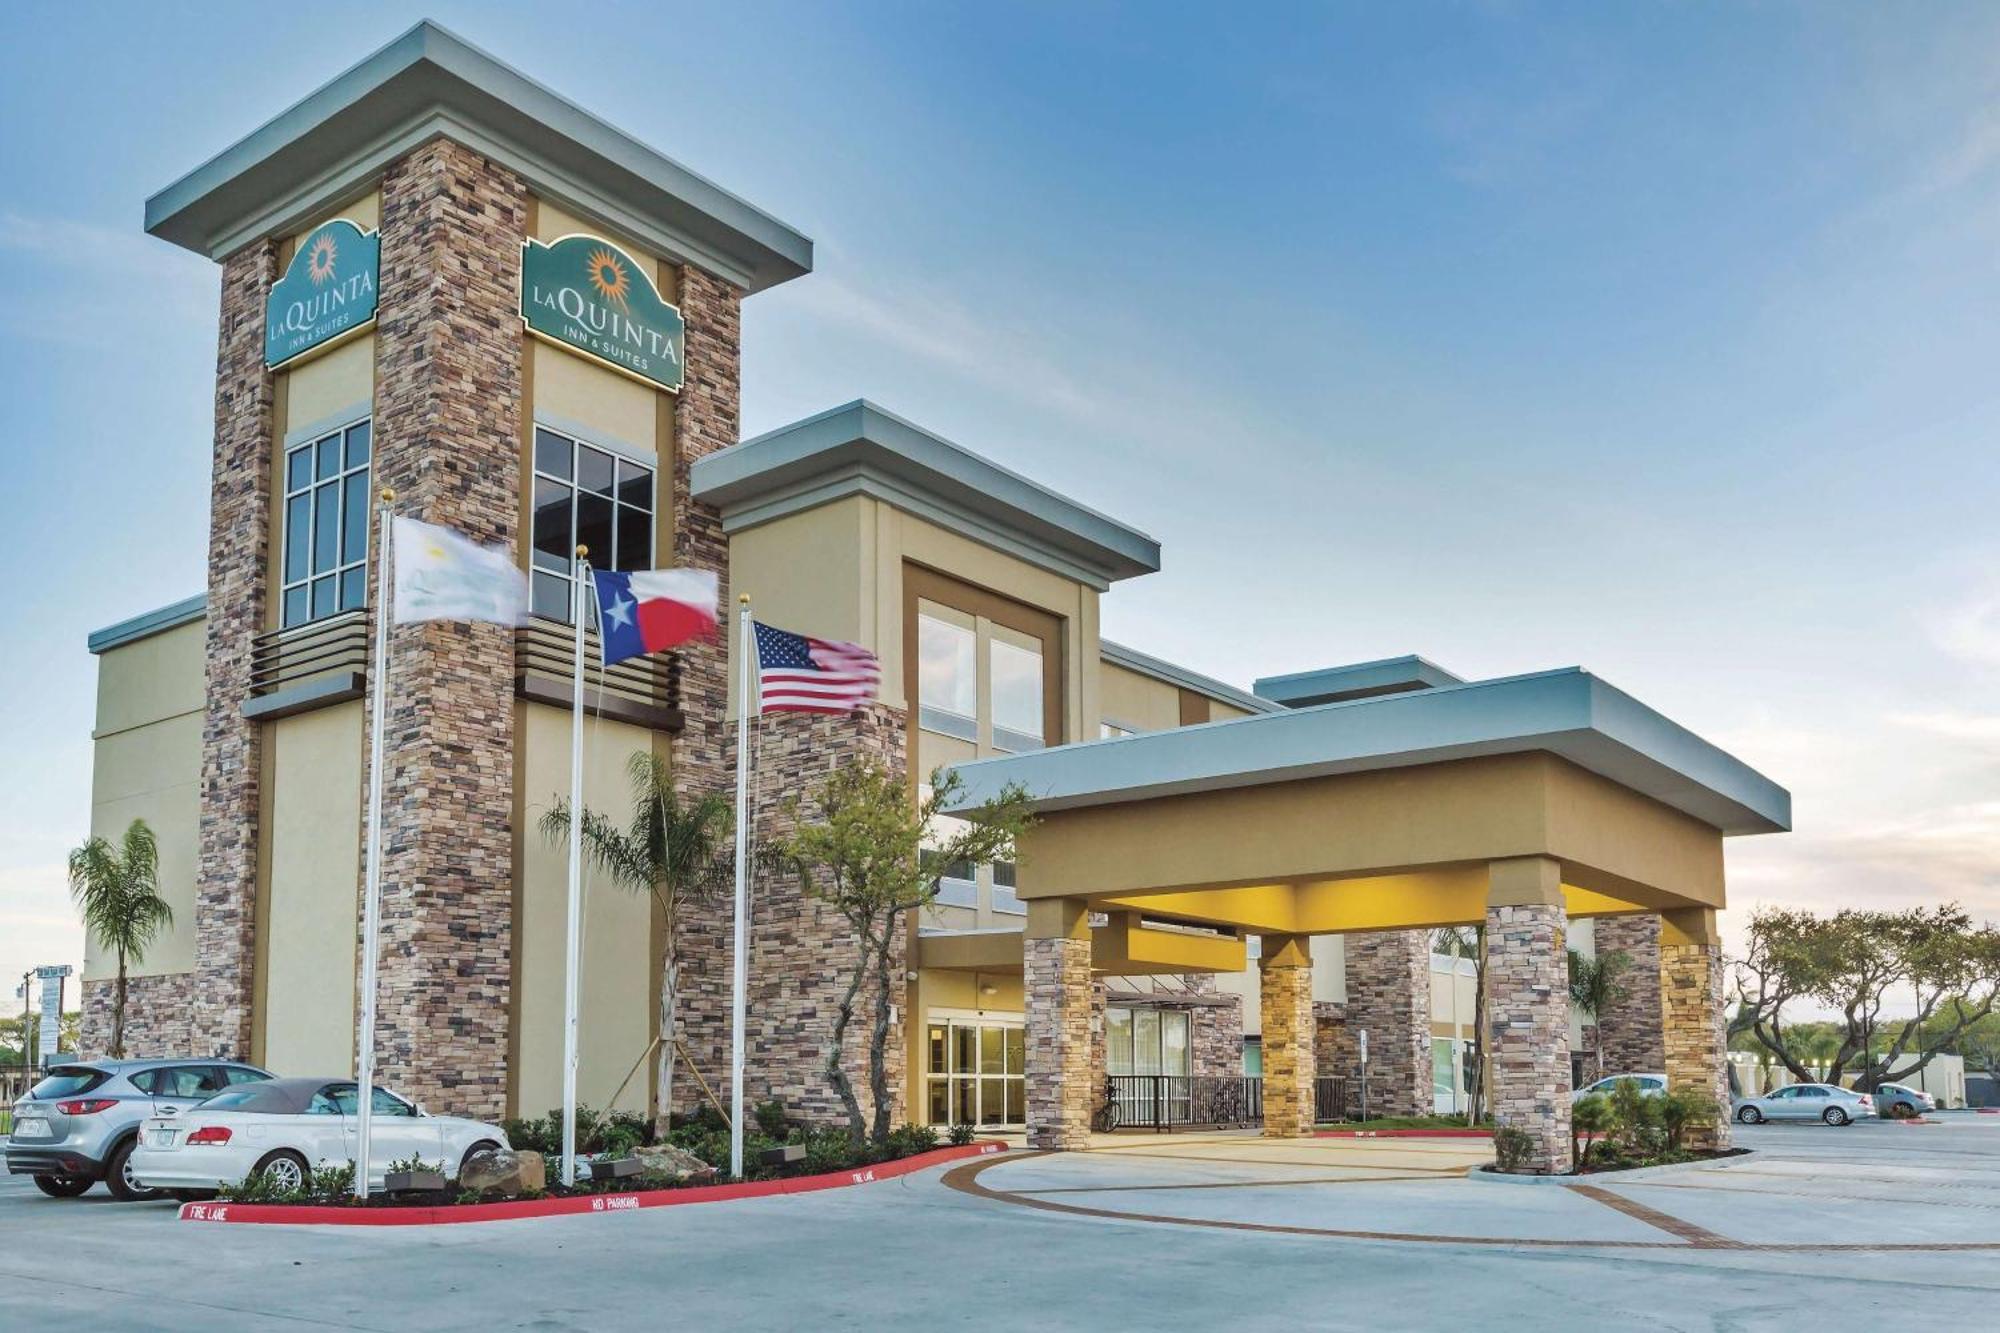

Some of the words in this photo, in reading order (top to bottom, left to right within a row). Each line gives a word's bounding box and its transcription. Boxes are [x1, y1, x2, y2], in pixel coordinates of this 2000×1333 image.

[271, 320, 285, 341] LA
[286, 269, 373, 331] QUINTA
[533, 286, 556, 311] LA
[558, 287, 679, 365] QUINTA
[289, 334, 306, 350] INN
[315, 312, 350, 338] SUITES
[563, 324, 588, 343] INN
[591, 339, 599, 349] &
[602, 342, 649, 370] SUITES
[207, 1206, 228, 1221] LANE
[606, 1196, 640, 1210] PARKING
